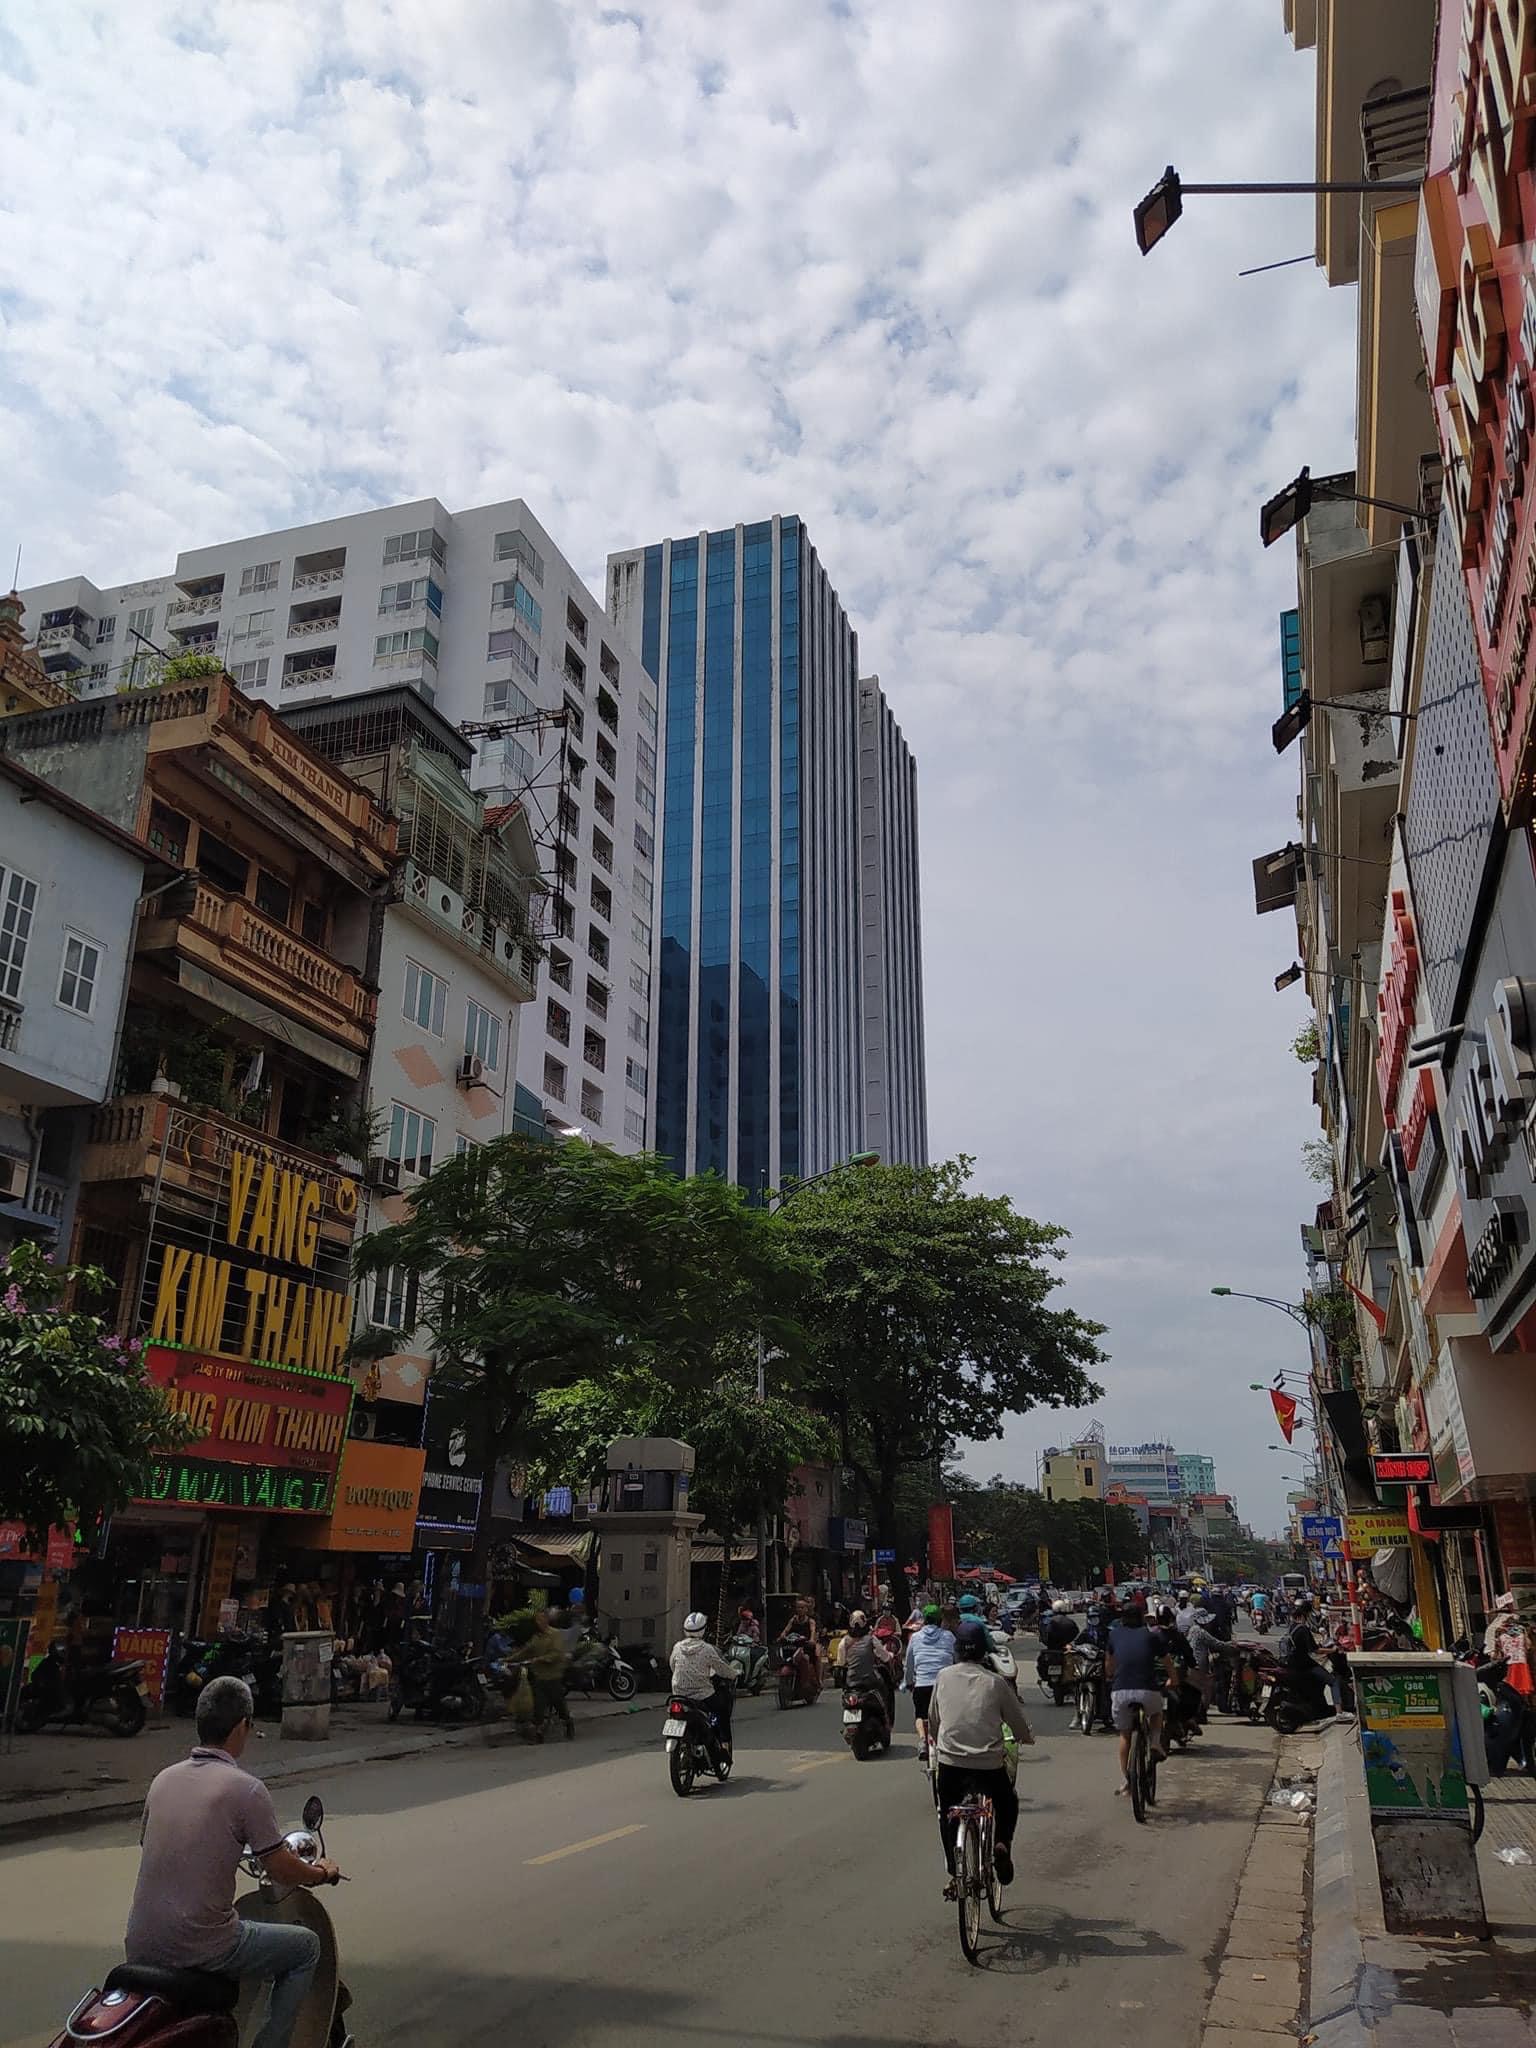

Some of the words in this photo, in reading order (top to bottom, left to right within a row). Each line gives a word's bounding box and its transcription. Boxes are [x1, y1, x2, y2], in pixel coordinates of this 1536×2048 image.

[227, 1146, 320, 1267] VÀNG
[152, 1244, 231, 1352] KIM
[242, 1269, 353, 1376] THANH
[166, 1377, 217, 1433] ÀNG
[219, 1398, 272, 1445] KIM
[273, 1406, 346, 1455] THANH
[345, 1485, 414, 1511] BOUTIQUE
[120, 1634, 165, 1656] VÀNG
[1404, 1693, 1417, 1706] 15
